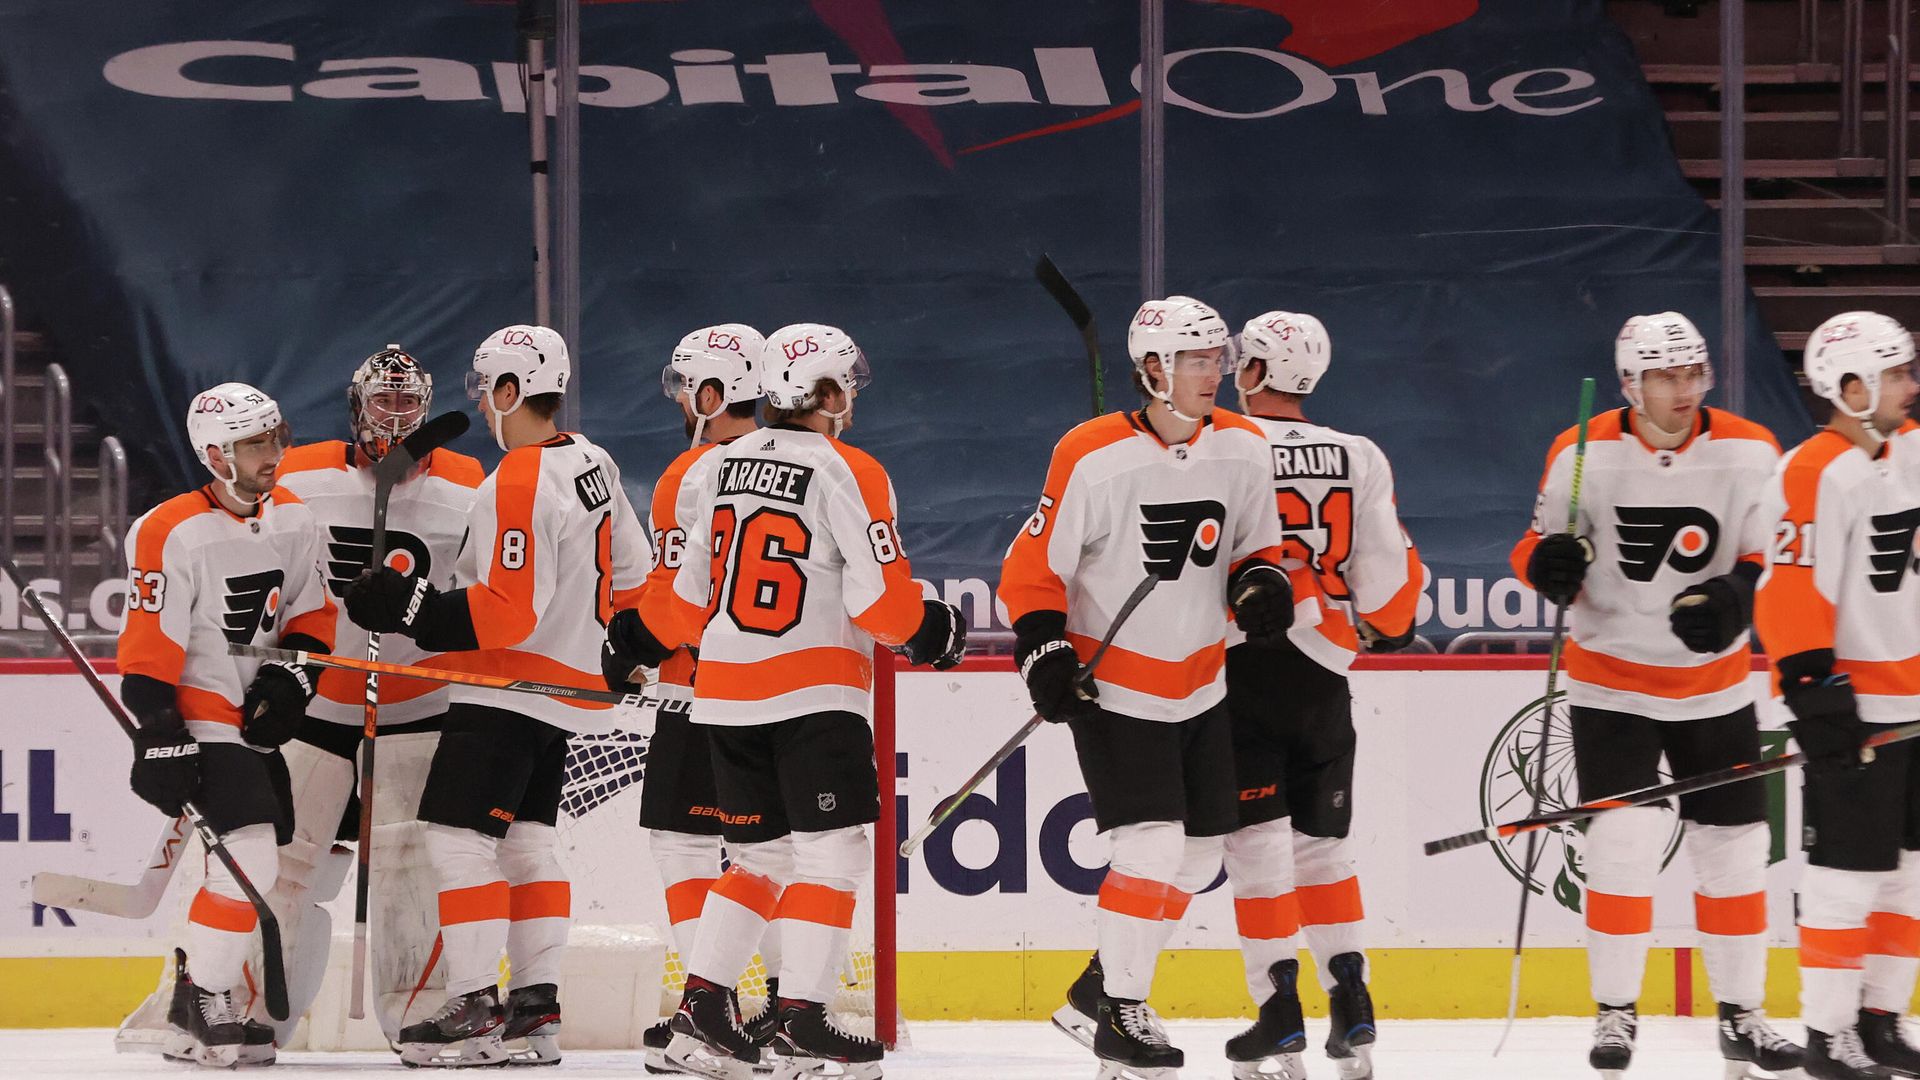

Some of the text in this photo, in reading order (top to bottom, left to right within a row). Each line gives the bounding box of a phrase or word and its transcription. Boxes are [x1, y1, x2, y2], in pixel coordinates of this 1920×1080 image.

[103, 40, 1603, 118] Capital One
[708, 329, 741, 352] tcs
[782, 336, 819, 361] tcs
[500, 528, 527, 570] 8
[651, 527, 687, 571] 56
[128, 567, 168, 614] 53
[619, 693, 694, 716] BAU
